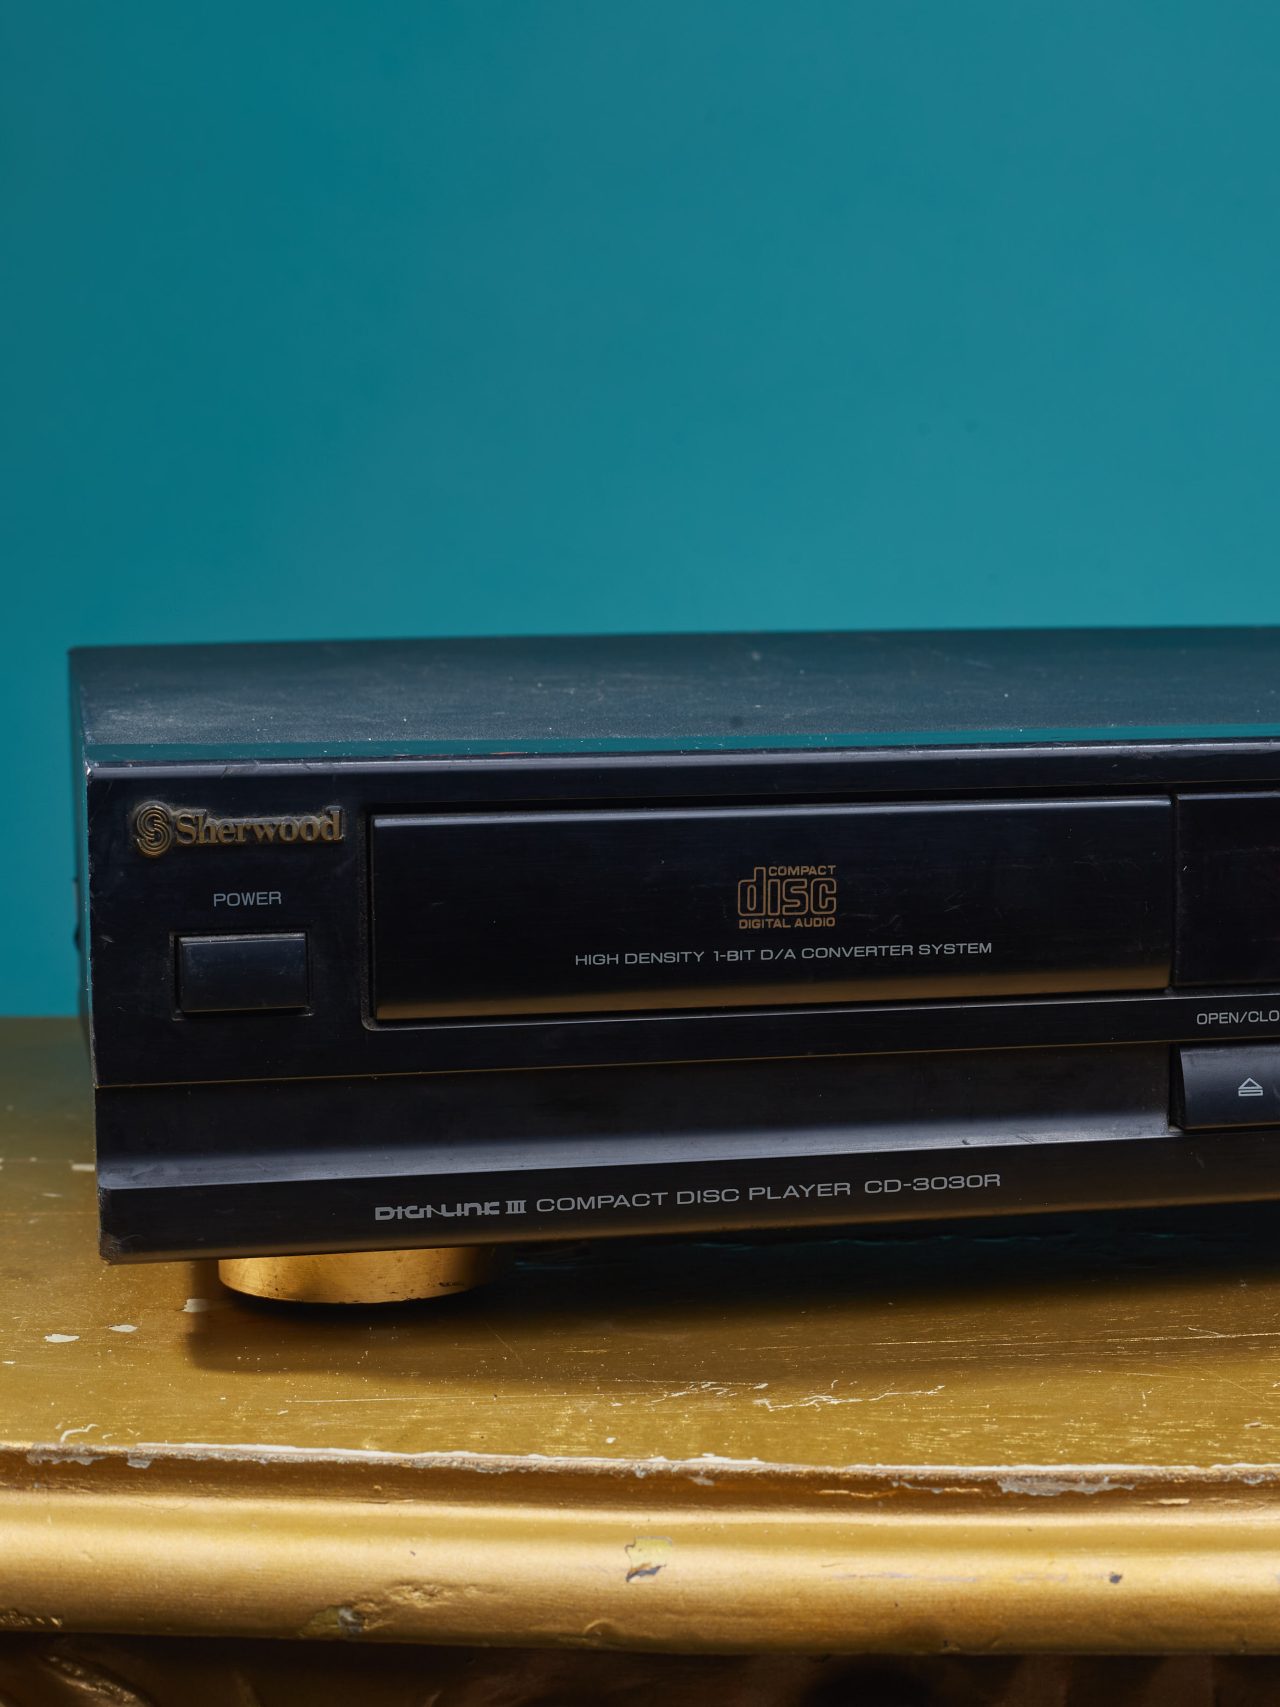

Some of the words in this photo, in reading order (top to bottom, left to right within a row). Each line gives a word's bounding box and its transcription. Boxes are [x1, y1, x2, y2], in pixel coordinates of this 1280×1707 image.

[175, 808, 343, 845] Sherwood
[768, 864, 836, 877] COMPACT
[213, 891, 282, 907] POWER
[738, 918, 792, 930] DIGITAL
[794, 917, 836, 928] AUDIO
[575, 952, 620, 966] HIGH
[624, 950, 705, 965] DENSITY
[713, 949, 756, 962] 1-BIT
[760, 948, 797, 961] D/A
[801, 944, 914, 960] CONVERTER
[918, 942, 993, 956] SYSTEM
[536, 1191, 669, 1213] COMPACT
[676, 1188, 740, 1206] DISC
[749, 1182, 851, 1201] PLAYER
[864, 1173, 1002, 1195] CD-3030R
